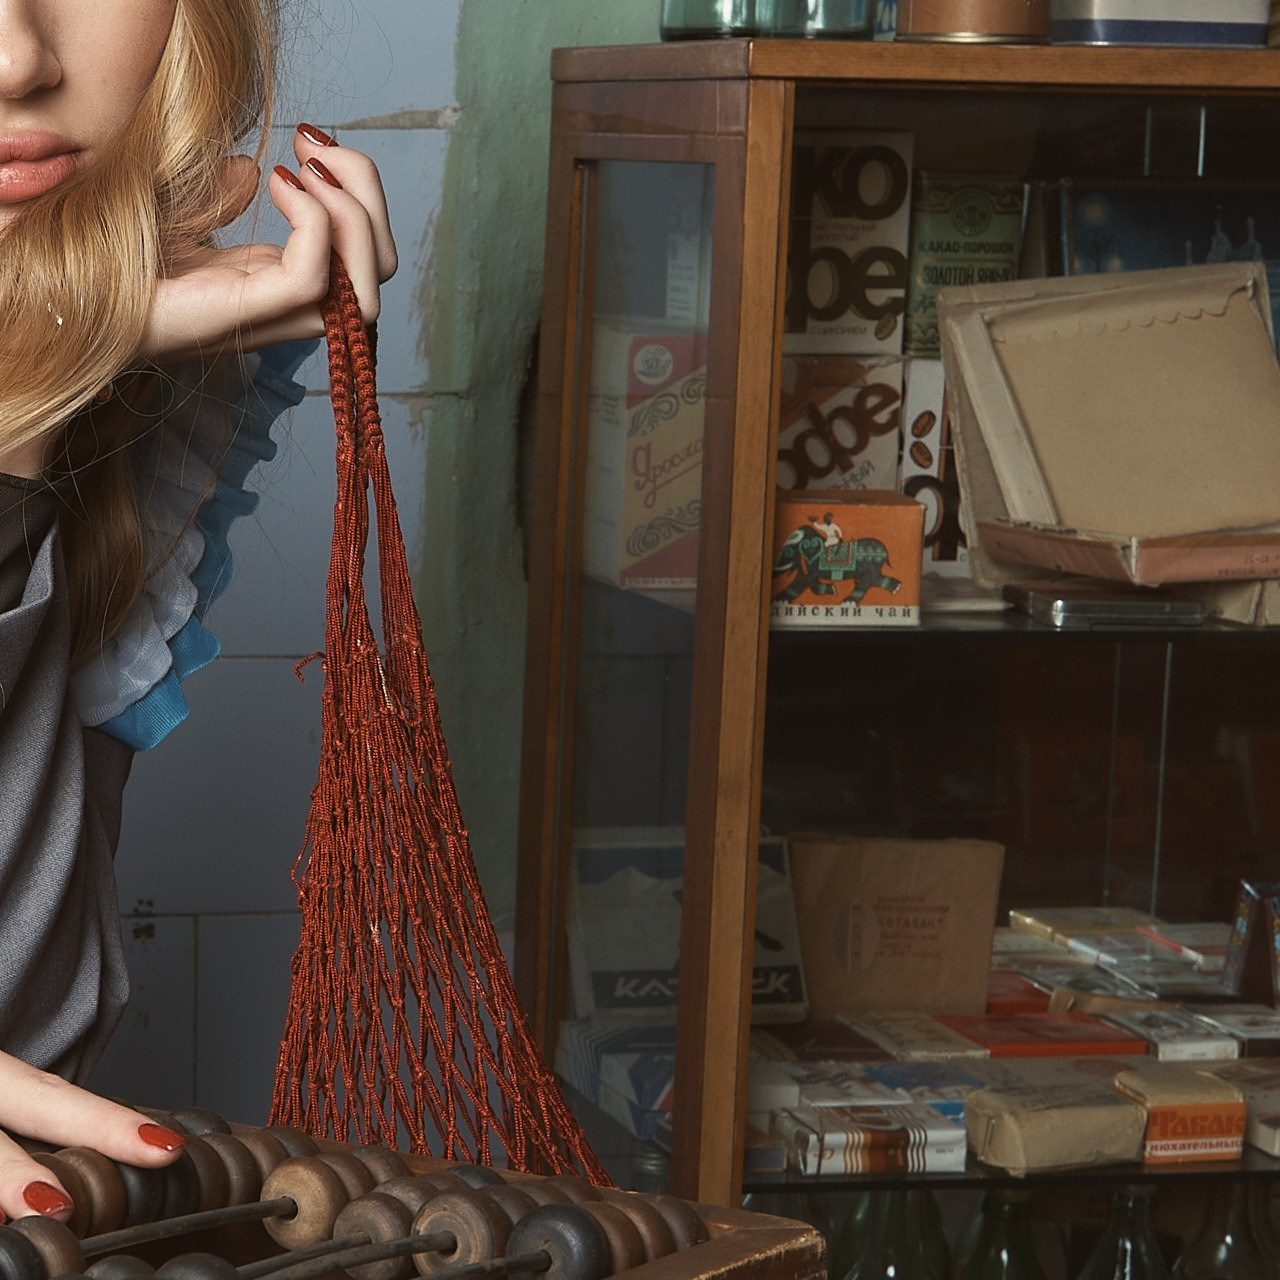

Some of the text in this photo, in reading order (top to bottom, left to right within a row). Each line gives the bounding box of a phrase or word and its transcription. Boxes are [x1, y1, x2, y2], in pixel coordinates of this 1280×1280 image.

[919, 240, 1016, 255] КАКАО-ПОРОШОК
[923, 263, 974, 287] ЗОЛОТОЙ
[875, 604, 912, 618] чай
